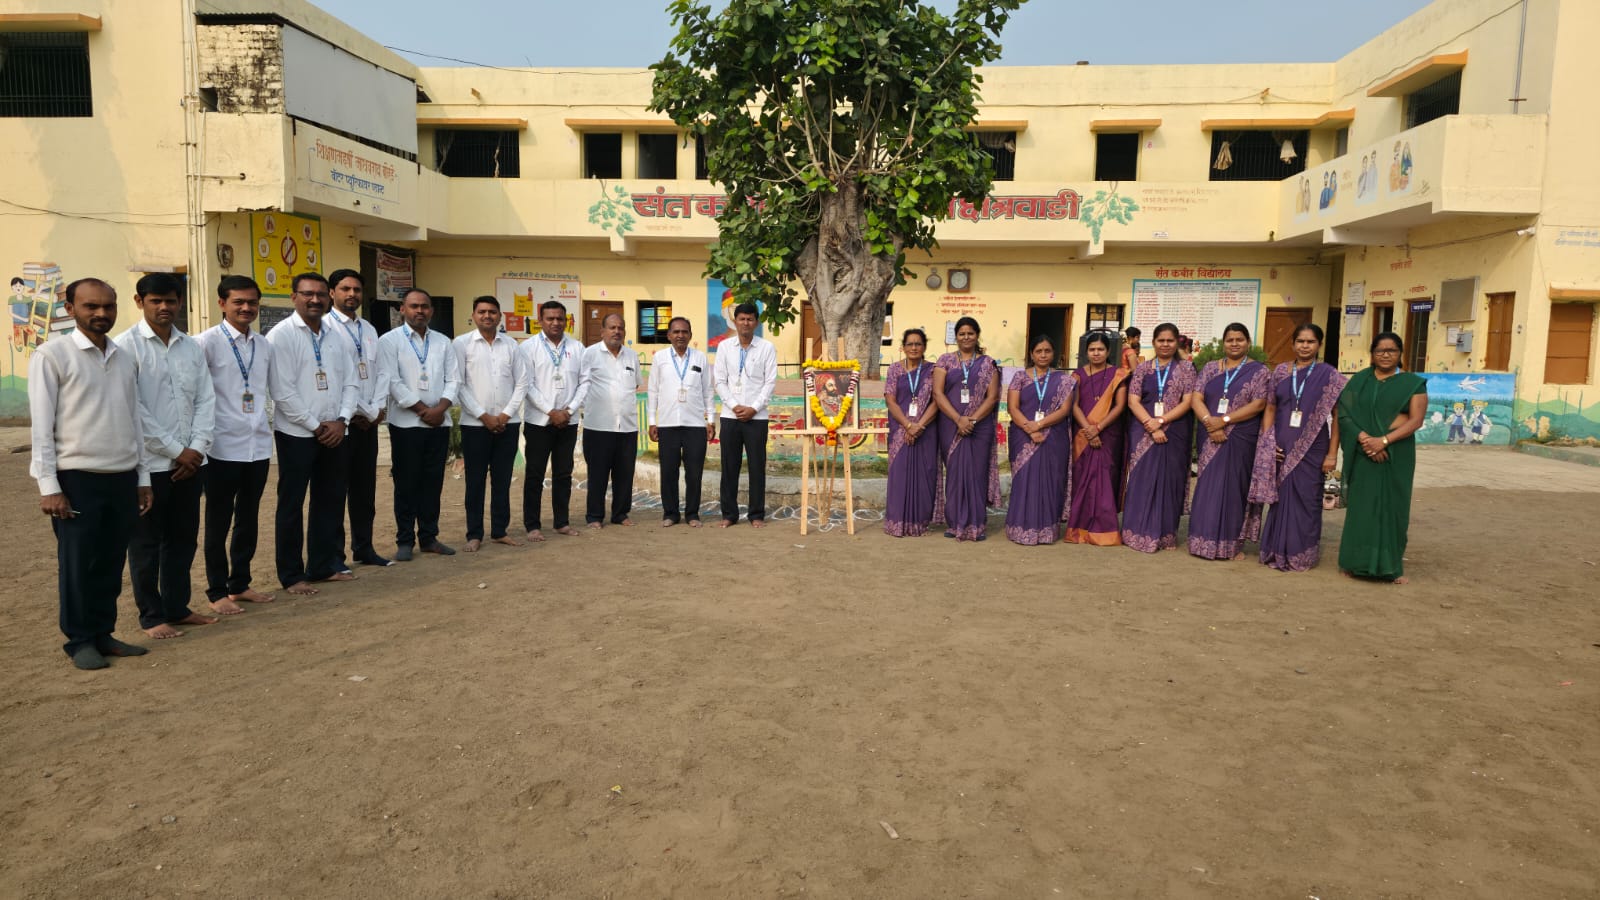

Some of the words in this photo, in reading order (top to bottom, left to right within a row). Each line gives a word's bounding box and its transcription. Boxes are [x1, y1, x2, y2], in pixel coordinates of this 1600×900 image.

[631, 186, 692, 219] संत
[1155, 267, 1169, 279] संत
[1171, 266, 1194, 279] कबीर
[1197, 266, 1232, 279] विद्यालय
